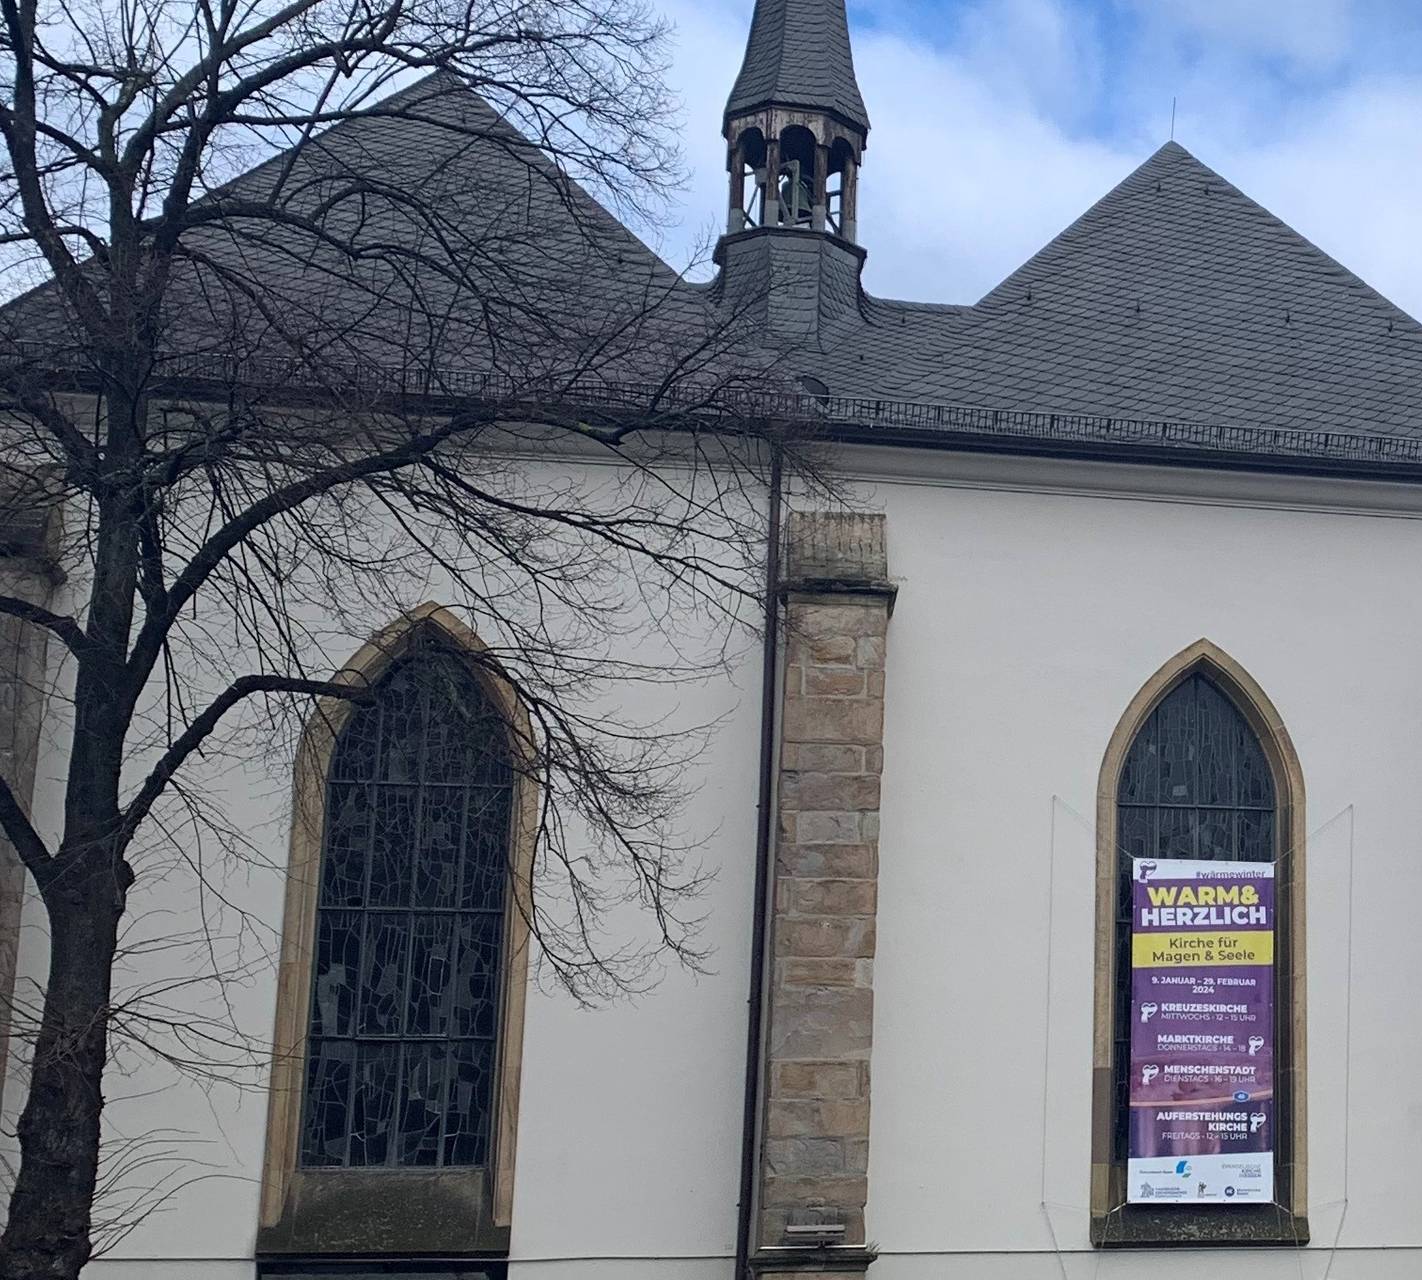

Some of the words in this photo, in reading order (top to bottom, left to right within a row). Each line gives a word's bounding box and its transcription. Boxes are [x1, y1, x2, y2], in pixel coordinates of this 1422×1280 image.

[1147, 885, 1259, 906] WARM&
[1141, 906, 1266, 926] HERZLICH
[1169, 936, 1214, 949] Kirche
[1217, 937, 1238, 949] für
[1152, 951, 1200, 964] Magen
[1204, 950, 1214, 961] &
[1219, 949, 1255, 961] Seele
[1152, 976, 1159, 984] 9.
[1161, 976, 1195, 985] JANUAR
[1203, 977, 1216, 986] 29.
[1217, 978, 1256, 986] FEBRUAR
[1192, 985, 1215, 994] 2024
[1161, 1003, 1247, 1013] KREUZESKIRCHE
[1161, 1013, 1210, 1021] MITTWOCHS
[1239, 1013, 1256, 1022] UHR
[1157, 1034, 1234, 1044] MARKTKIRCHE
[1164, 1065, 1256, 1075] MENSCHENSTADT
[1164, 1075, 1209, 1083] DIENSTAGS
[1156, 1112, 1247, 1121] AUFERSTEHUNGS
[1208, 1122, 1247, 1132] KIRCHE
[1162, 1132, 1200, 1140] FREITAGS
[1230, 1132, 1247, 1140] UHR
